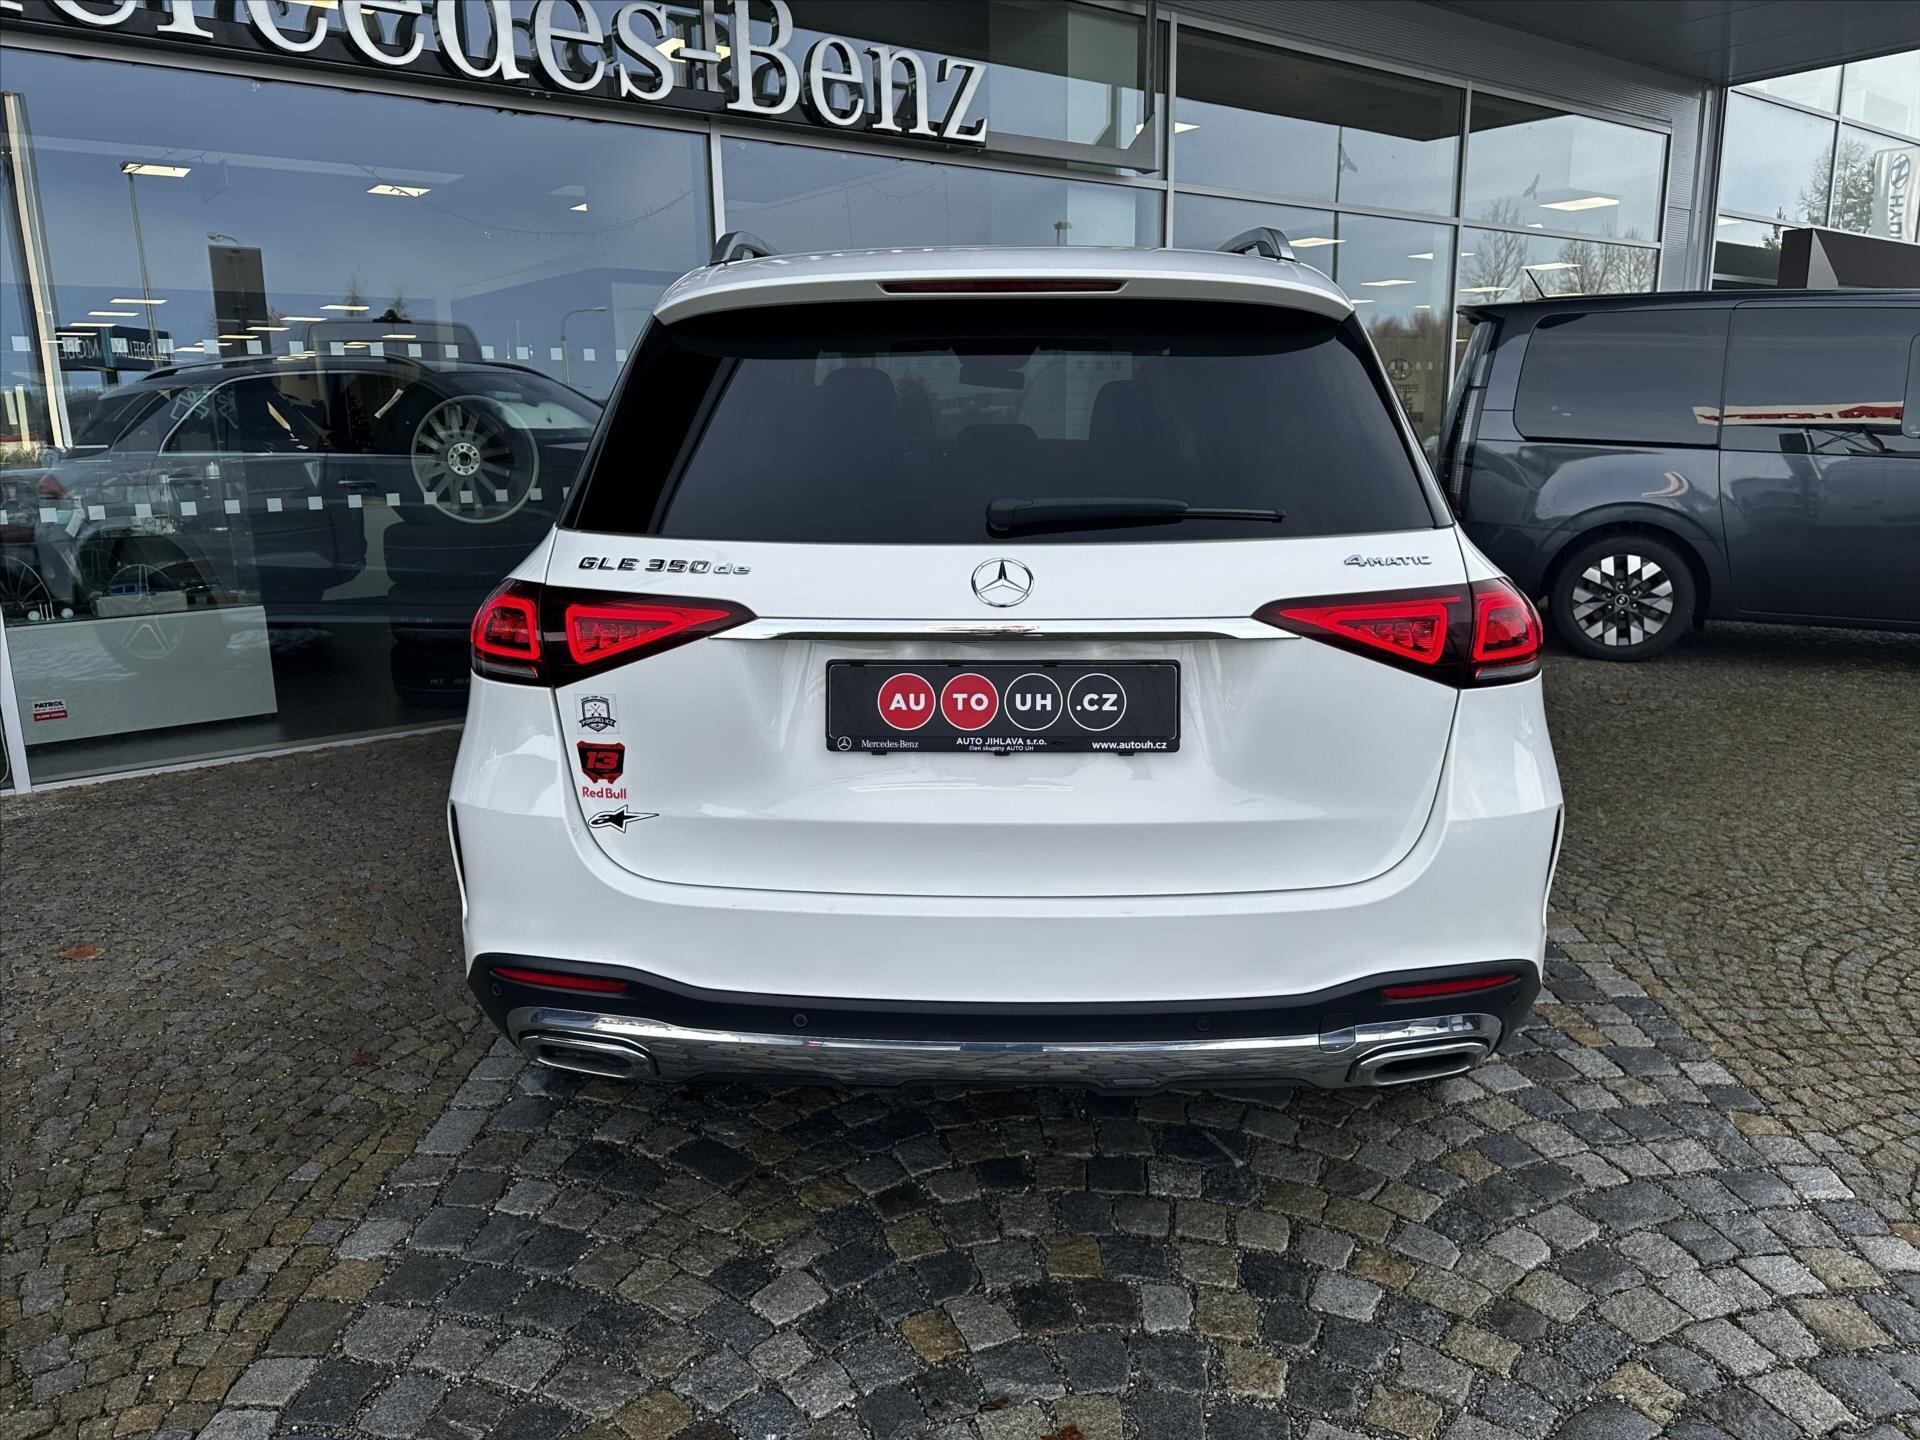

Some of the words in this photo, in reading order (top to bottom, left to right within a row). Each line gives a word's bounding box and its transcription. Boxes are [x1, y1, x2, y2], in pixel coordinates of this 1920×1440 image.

[578, 556, 640, 571] GLE
[1343, 554, 1432, 567] 4MATIC
[33, 701, 65, 709] PATROL
[889, 693, 926, 711] AU
[952, 693, 989, 711] TO
[1015, 693, 1052, 711] UH
[861, 739, 919, 749] Mercedes-Benz
[956, 737, 983, 745] AUTO
[985, 737, 1024, 745] JIHLAVA
[1092, 740, 1167, 749] www.autouh.cz
[586, 751, 619, 770] 13
[582, 786, 604, 798] Red
[605, 787, 626, 799] Bull
